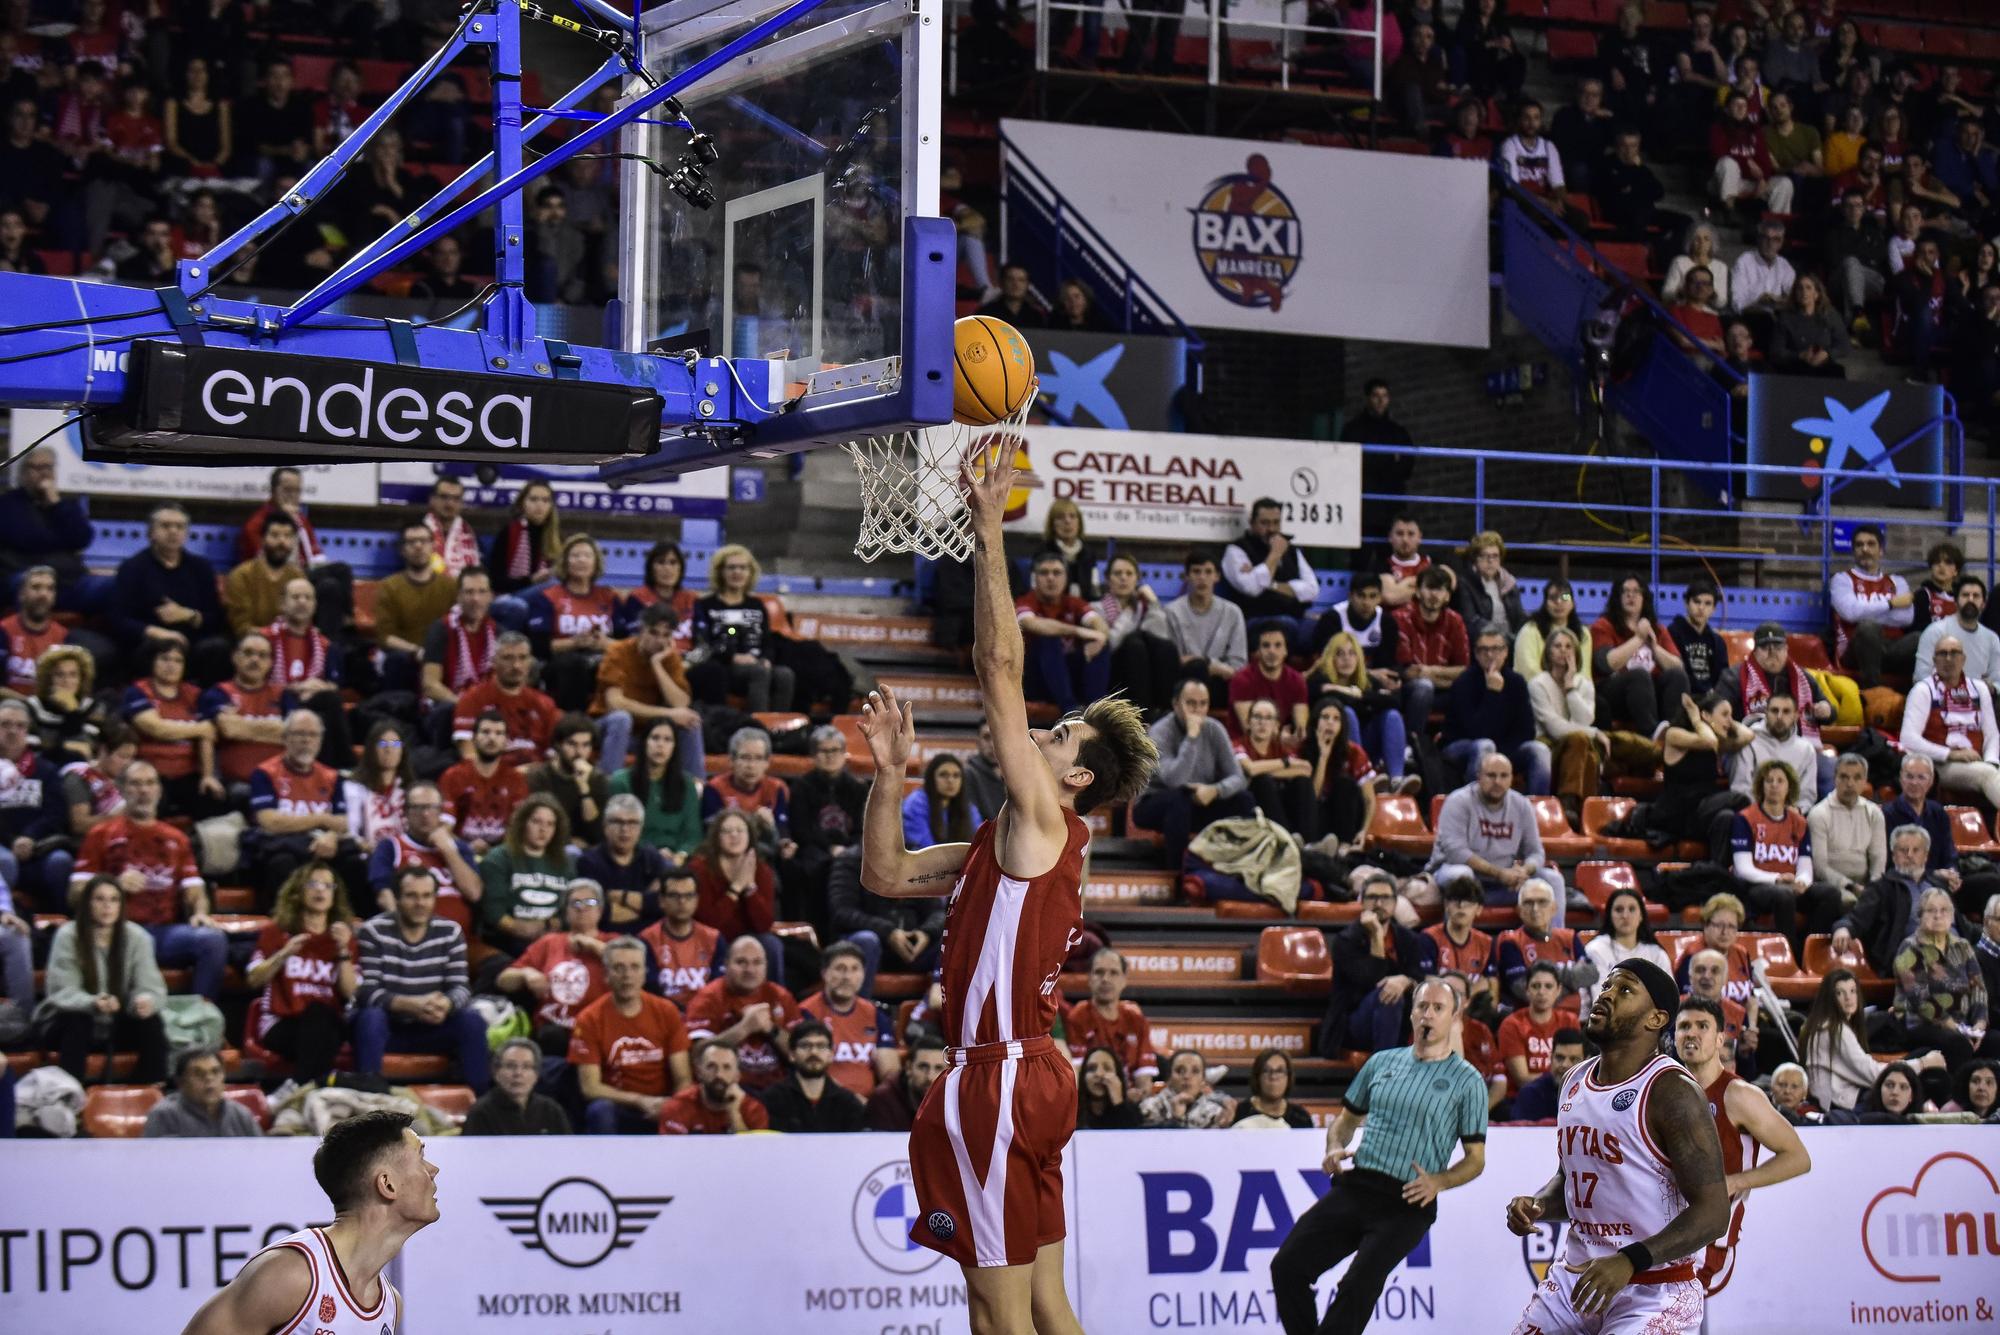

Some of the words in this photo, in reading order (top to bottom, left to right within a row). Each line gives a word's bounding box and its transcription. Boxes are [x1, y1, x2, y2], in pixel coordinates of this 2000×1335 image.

[1197, 213, 1299, 256] BAXI
[202, 367, 533, 449] endesa
[1053, 450, 1242, 481] CATALANA
[1053, 478, 1095, 500] DE
[1103, 481, 1246, 508] TREBALL
[1128, 956, 1179, 972] TEGES
[1183, 957, 1236, 972] BAGES
[1172, 1033, 1246, 1049] NETEGES
[1251, 1034, 1304, 1050] BAGES
[1571, 1170, 1599, 1209] 17
[547, 1211, 609, 1234] MINI
[478, 1294, 571, 1316] MOTOR
[579, 1291, 681, 1314] MUNICH
[805, 1286, 904, 1311] MOTOR
[1851, 1300, 1969, 1325] innovation
[1975, 1296, 1994, 1322] &
